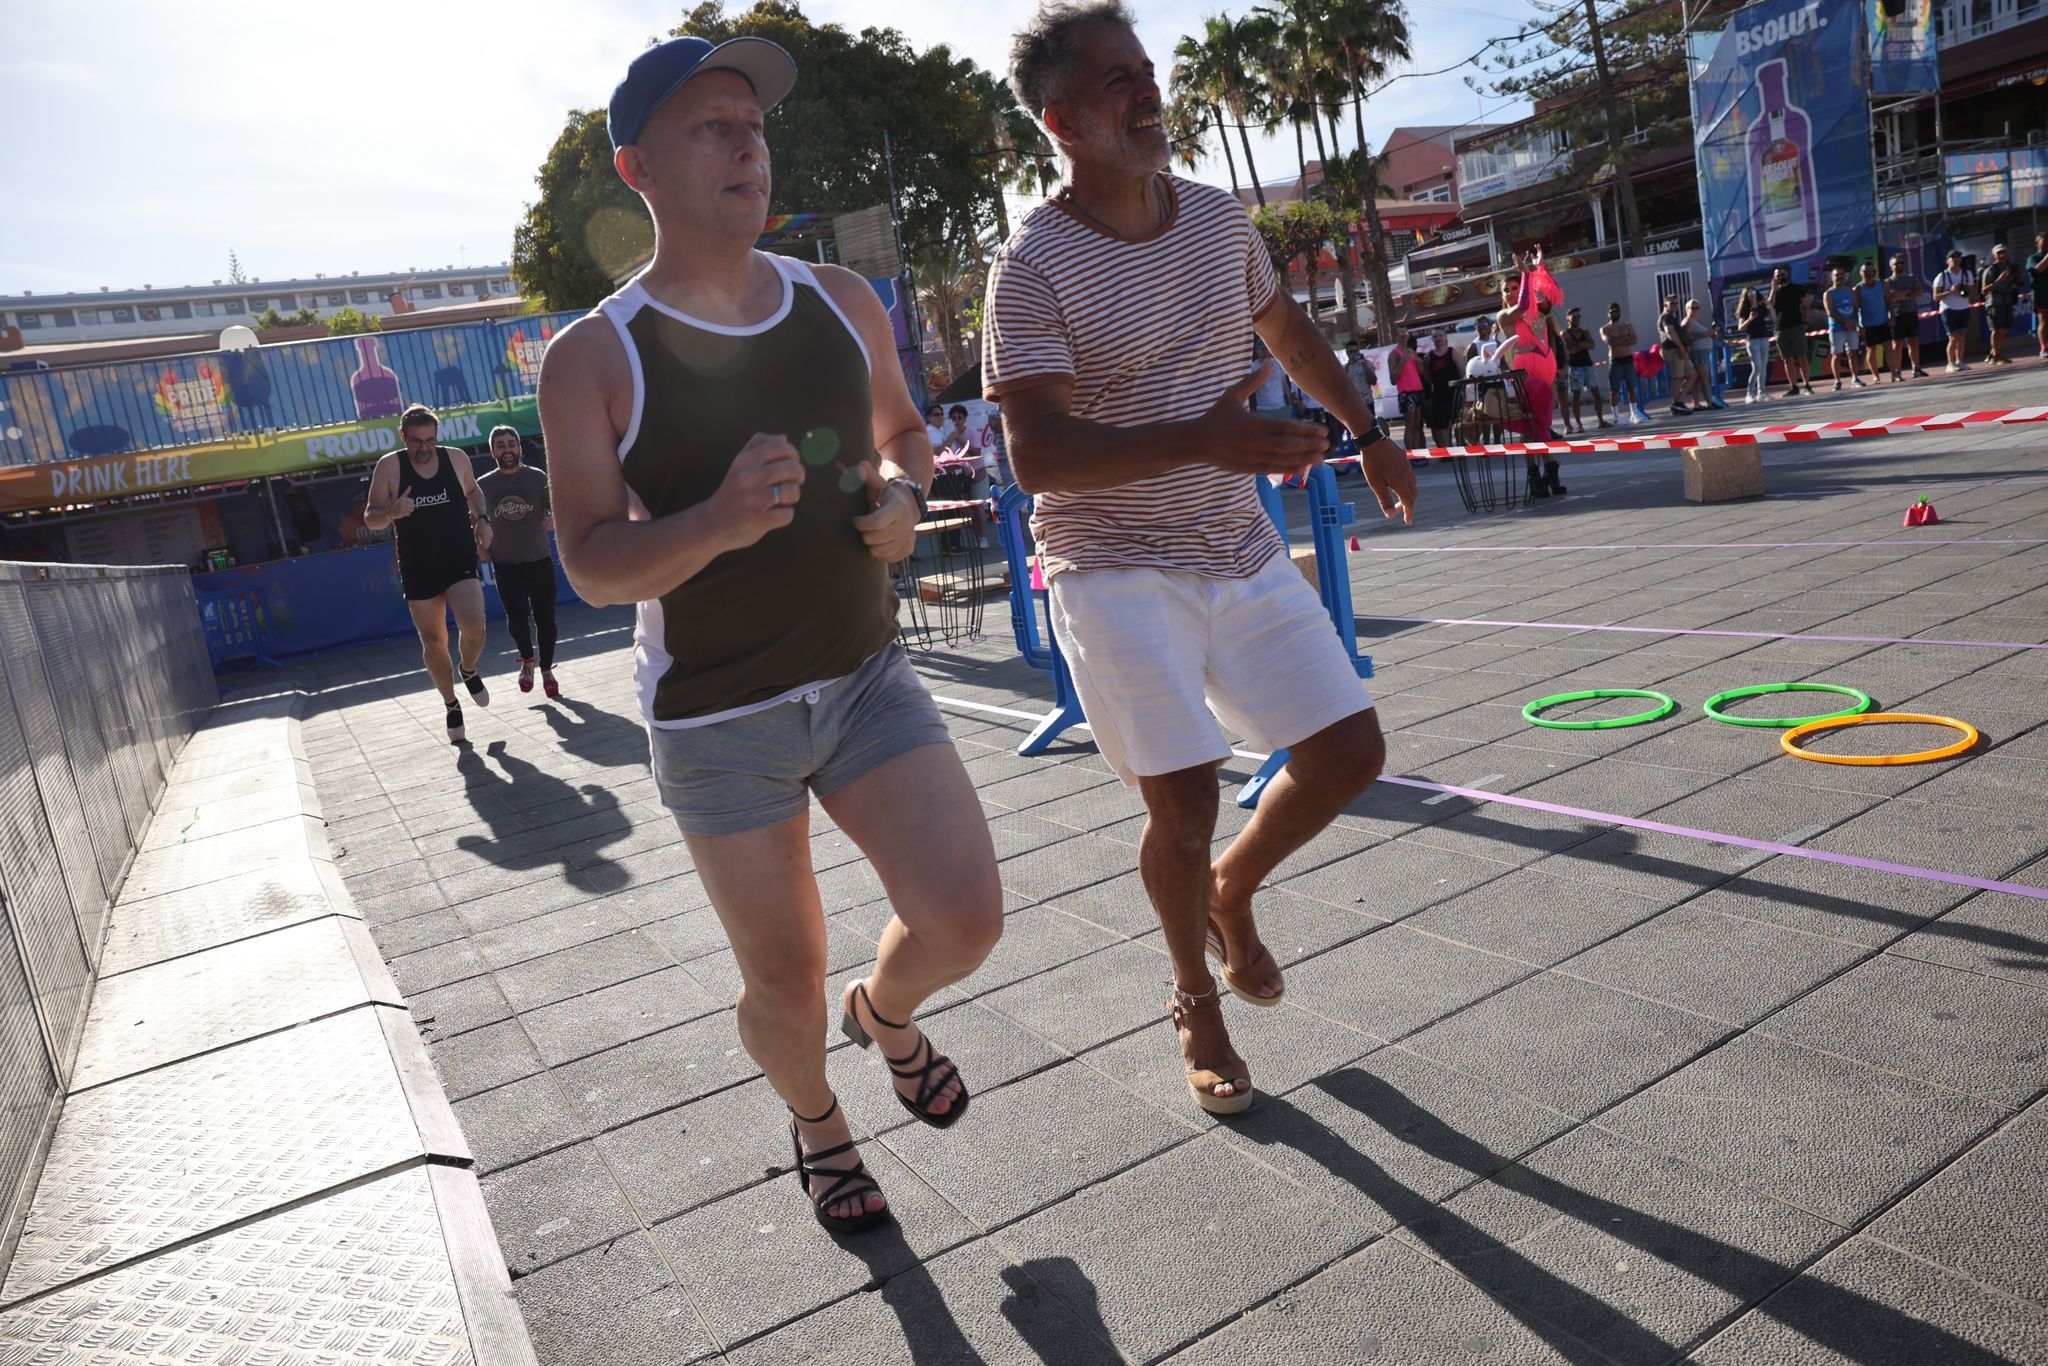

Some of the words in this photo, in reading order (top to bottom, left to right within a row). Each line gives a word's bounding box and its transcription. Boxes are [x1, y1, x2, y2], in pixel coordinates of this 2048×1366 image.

[1736, 2, 1828, 56] BSOLUT.
[1442, 226, 1472, 241] COSMOS
[1644, 244, 1656, 255] LE
[305, 428, 395, 461] PROUD
[437, 415, 482, 442] MIX
[51, 462, 128, 498] DRINK
[135, 454, 192, 487] HERE
[415, 488, 448, 508] proud
